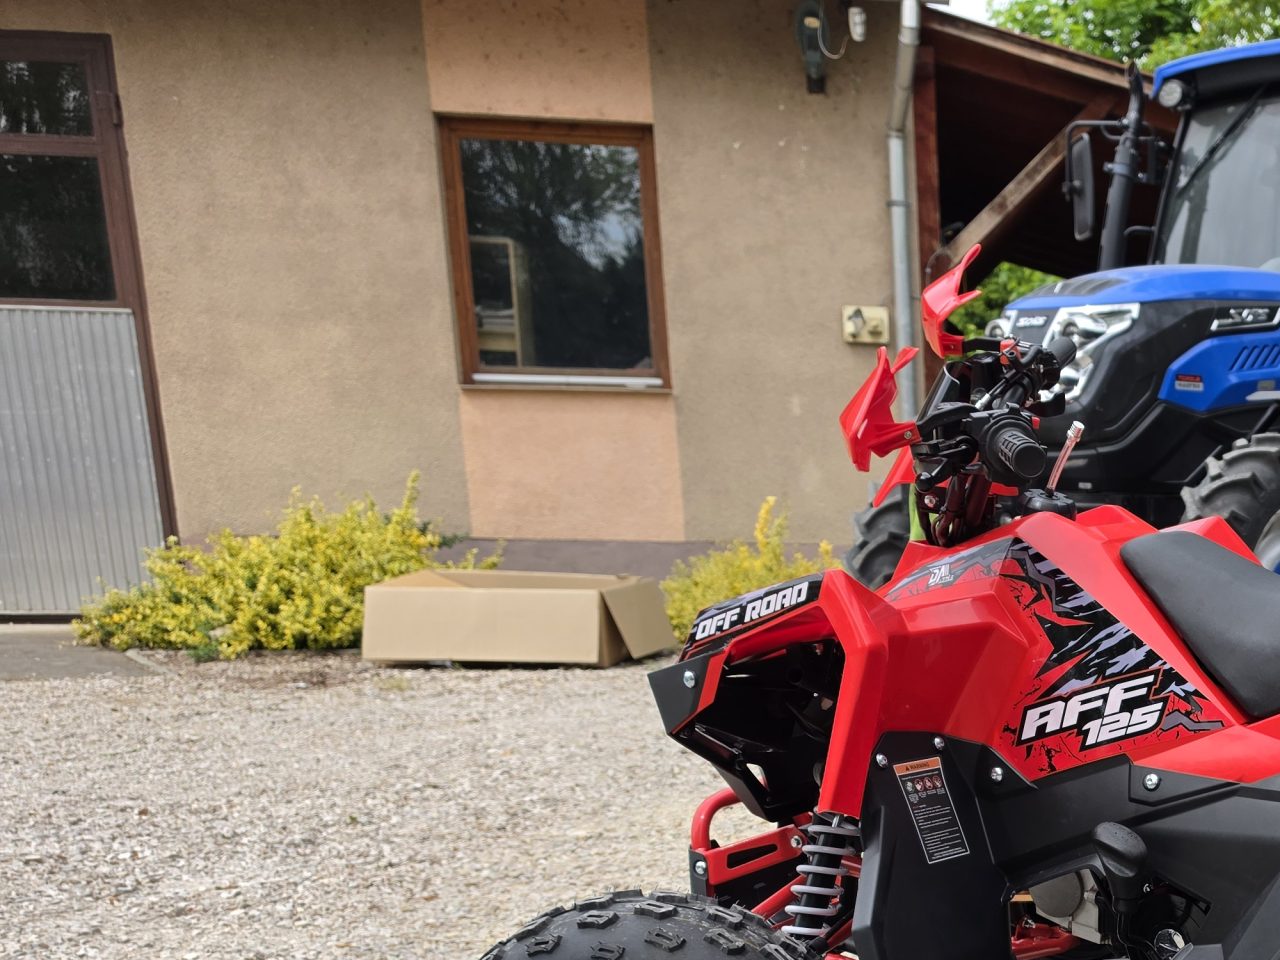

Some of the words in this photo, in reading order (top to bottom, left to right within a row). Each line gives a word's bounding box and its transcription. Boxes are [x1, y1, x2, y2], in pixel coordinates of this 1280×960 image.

[695, 607, 740, 640] OFF
[744, 581, 809, 623] ROAD
[1020, 674, 1155, 741] AFF
[1081, 701, 1164, 746] 125
